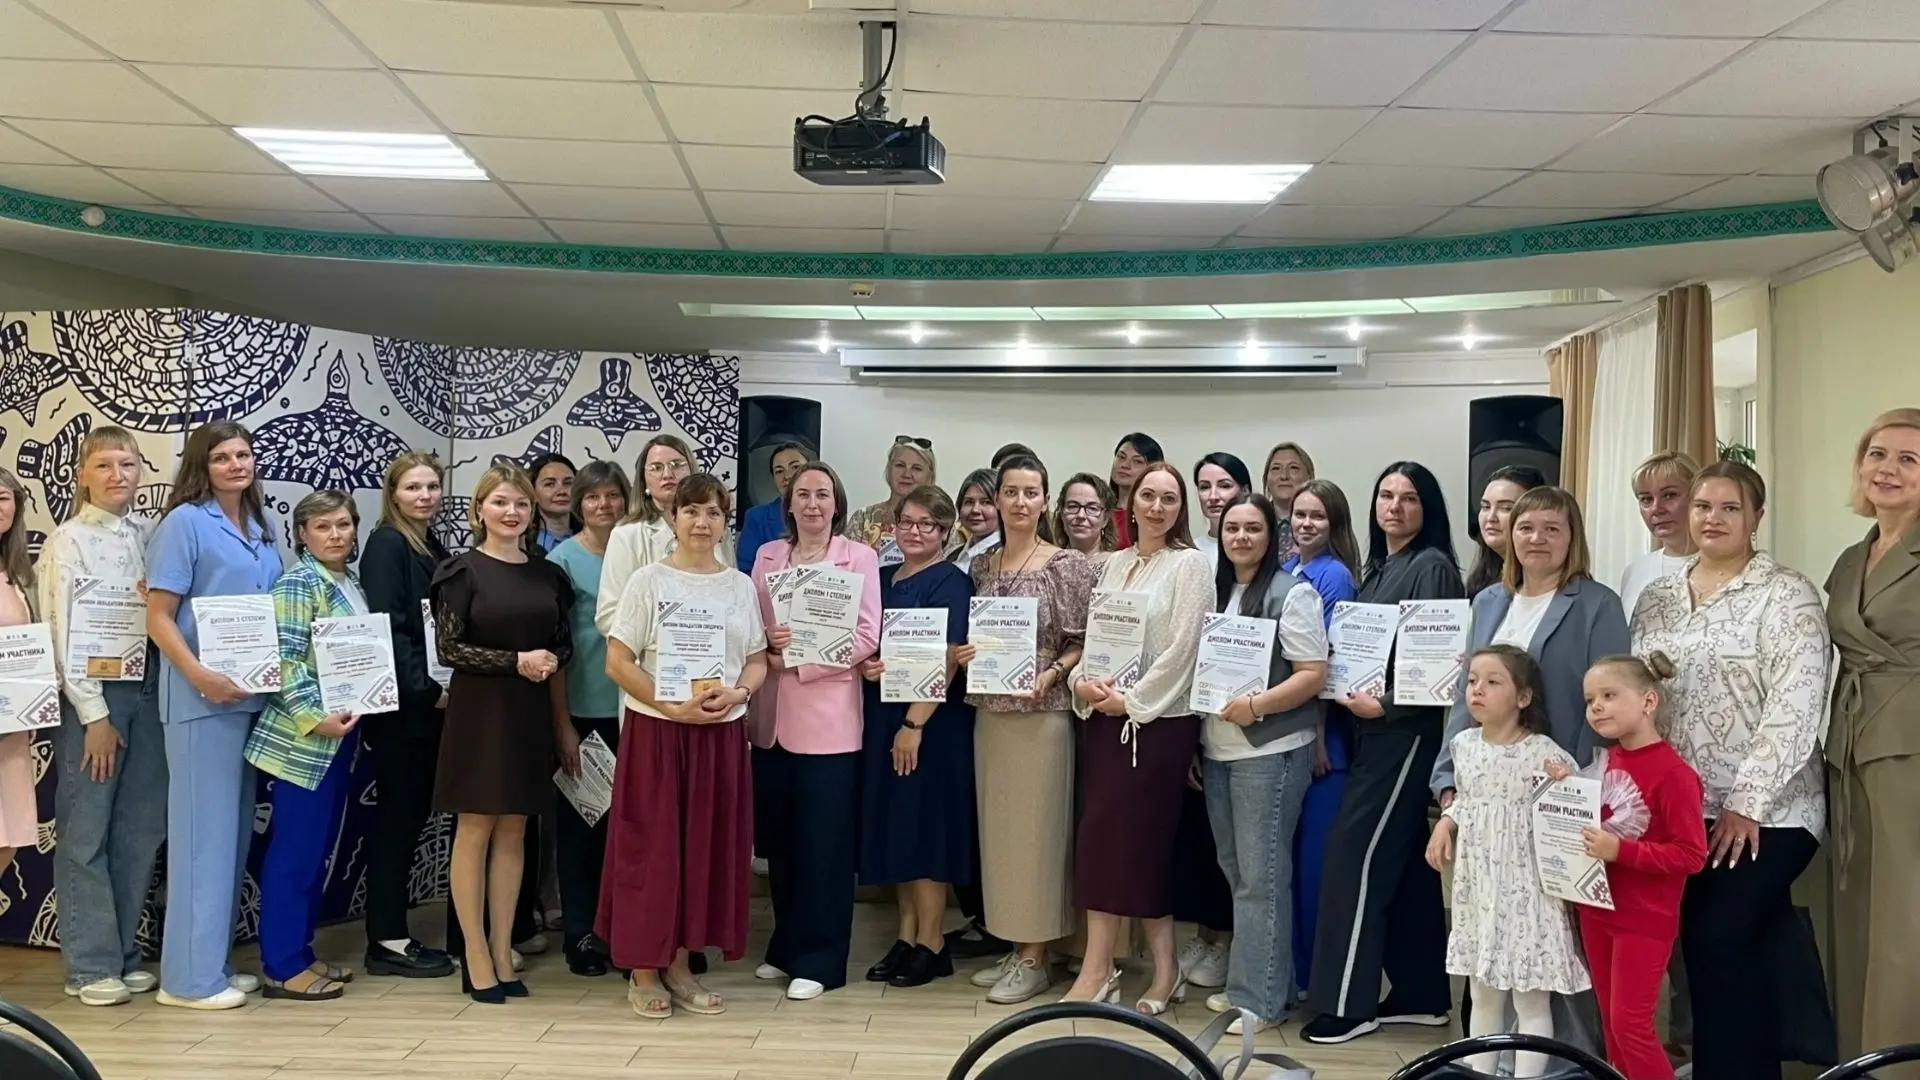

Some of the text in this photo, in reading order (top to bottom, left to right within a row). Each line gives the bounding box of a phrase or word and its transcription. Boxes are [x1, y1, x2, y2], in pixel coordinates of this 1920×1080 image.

[778, 592, 793, 602] ДИПЛ
[803, 587, 826, 597] ДИПЛОМ
[830, 591, 852, 601] СТЕПЕНИ
[241, 615, 266, 623] СТЕПЕНИ
[976, 619, 1031, 627] ДИПЛОМ УЧАСТНИКА
[1093, 612, 1141, 624] ДИПЛОМ УЧАСТНИКА
[1341, 622, 1362, 631] ДИПЛОМ
[1404, 624, 1460, 633] ДИПЛОМ УЧАСТНИКА
[888, 629, 941, 638] ДИПЛОМ УЧАСТНИКА
[1207, 635, 1266, 649] ДИПЛОМ УЧАСТНИКА
[6, 647, 46, 659] УЧАСТНИКА
[597, 767, 613, 788] УЧАСТ
[1538, 802, 1593, 819] ДИПЛОМ УЧАСТНИКА
